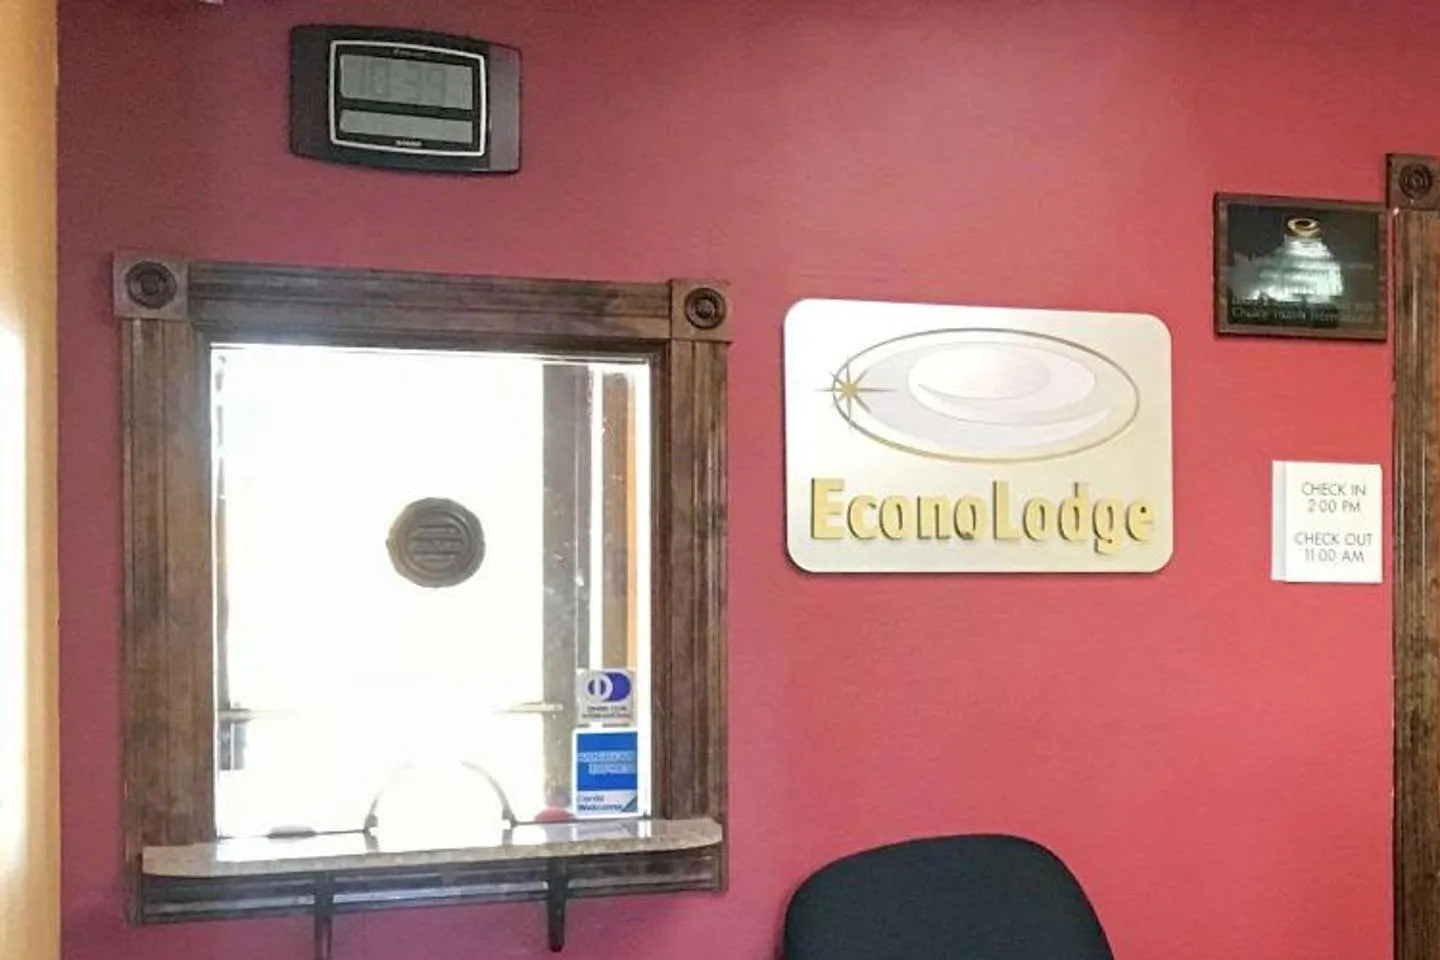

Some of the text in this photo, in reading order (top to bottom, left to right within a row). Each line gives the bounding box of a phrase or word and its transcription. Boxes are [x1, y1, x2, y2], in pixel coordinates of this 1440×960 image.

[1301, 481, 1367, 496] CHECK IN
[1342, 499, 1361, 513] PM
[810, 477, 1158, 554] EconoLodge
[1294, 531, 1374, 546] CHECK OUT
[1341, 549, 1365, 563] AM
